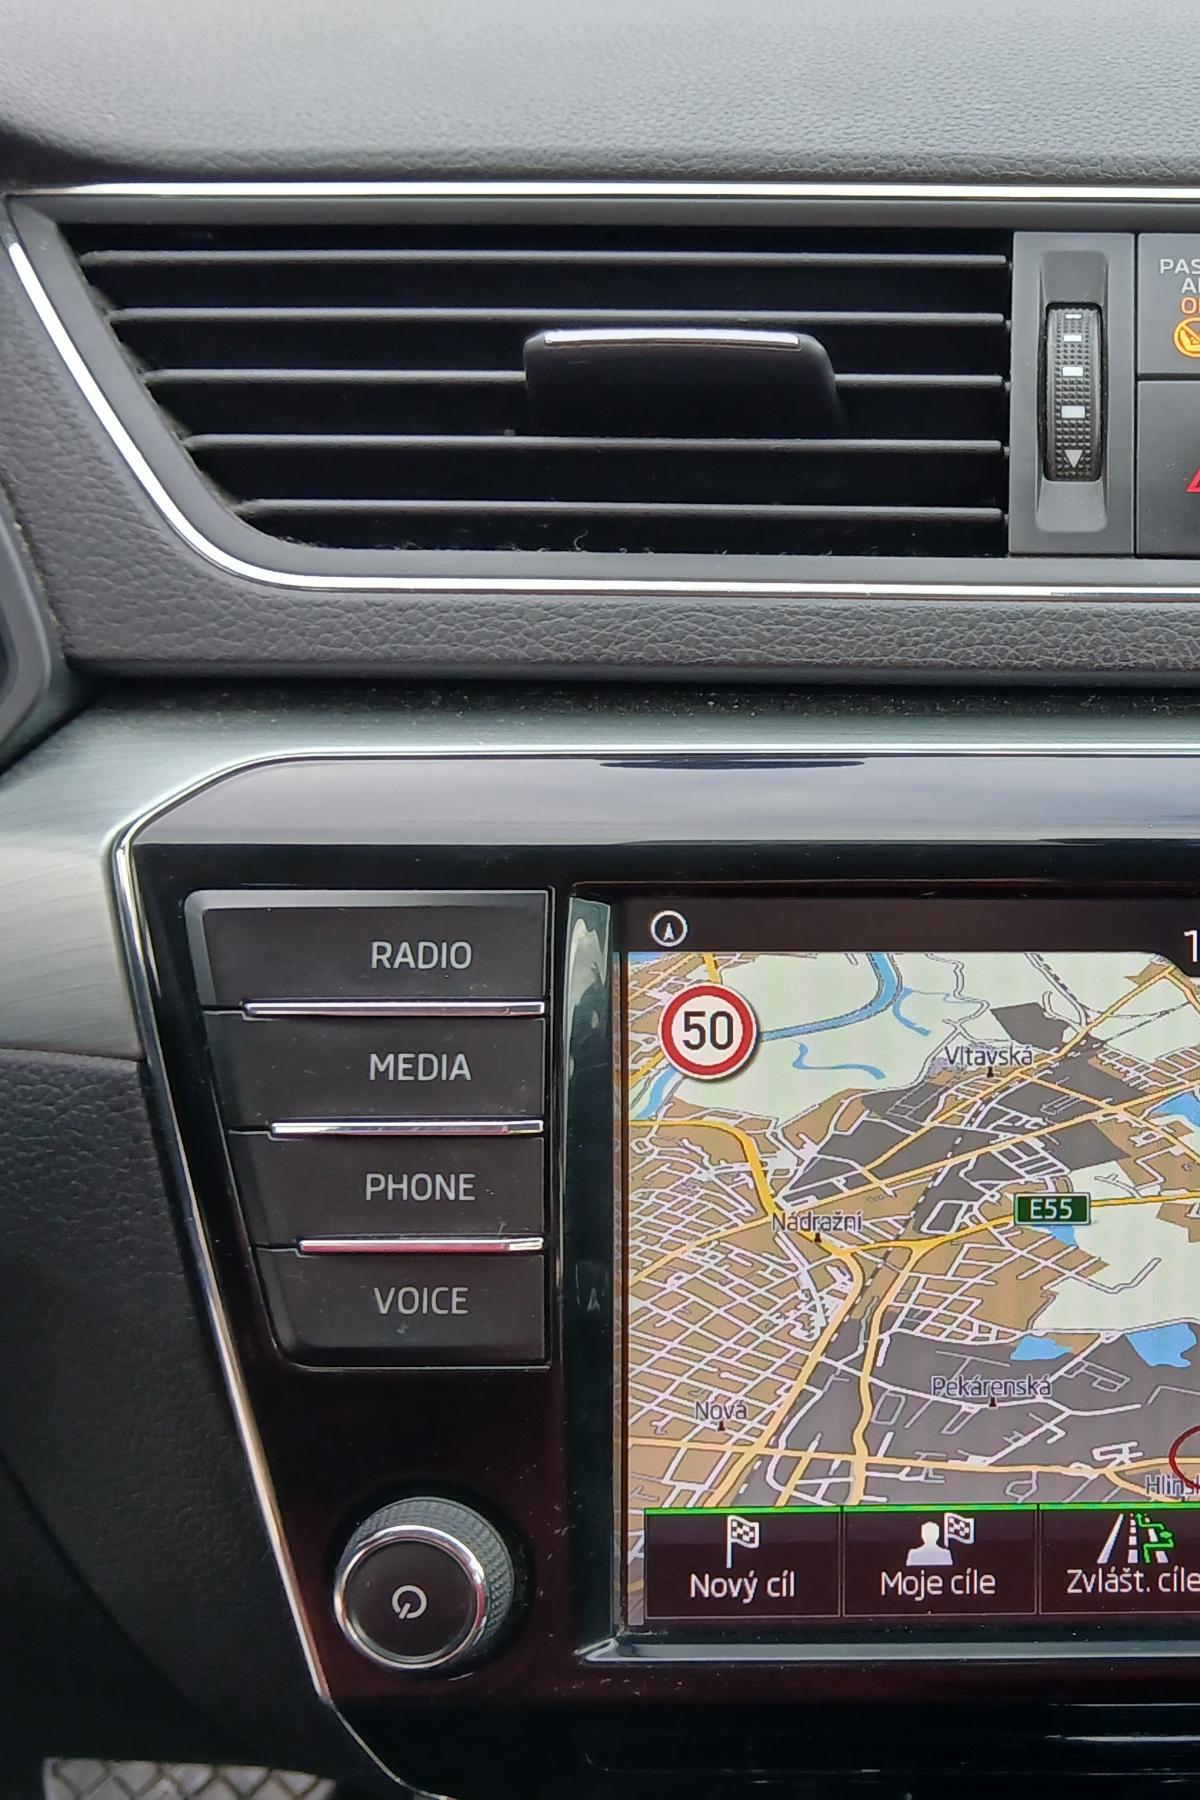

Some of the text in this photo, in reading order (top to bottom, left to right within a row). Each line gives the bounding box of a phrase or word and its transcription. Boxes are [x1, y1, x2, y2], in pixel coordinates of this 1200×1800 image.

[370, 941, 473, 970] RADIO
[682, 1011, 734, 1050] 50
[369, 1052, 472, 1081] MEDIA
[945, 1045, 1033, 1067] Vltavská
[365, 1173, 476, 1201] PHONE
[772, 1211, 863, 1233] Nádražní
[1030, 1198, 1073, 1220] E55
[373, 1287, 469, 1315] VOICE
[932, 1376, 1052, 1397] Pekárenská
[695, 1400, 748, 1421] Nová
[689, 1570, 795, 1603] Nový cíl
[881, 1567, 995, 1599] Moje cíle
[1066, 1567, 1151, 1593] Zvlášt.
